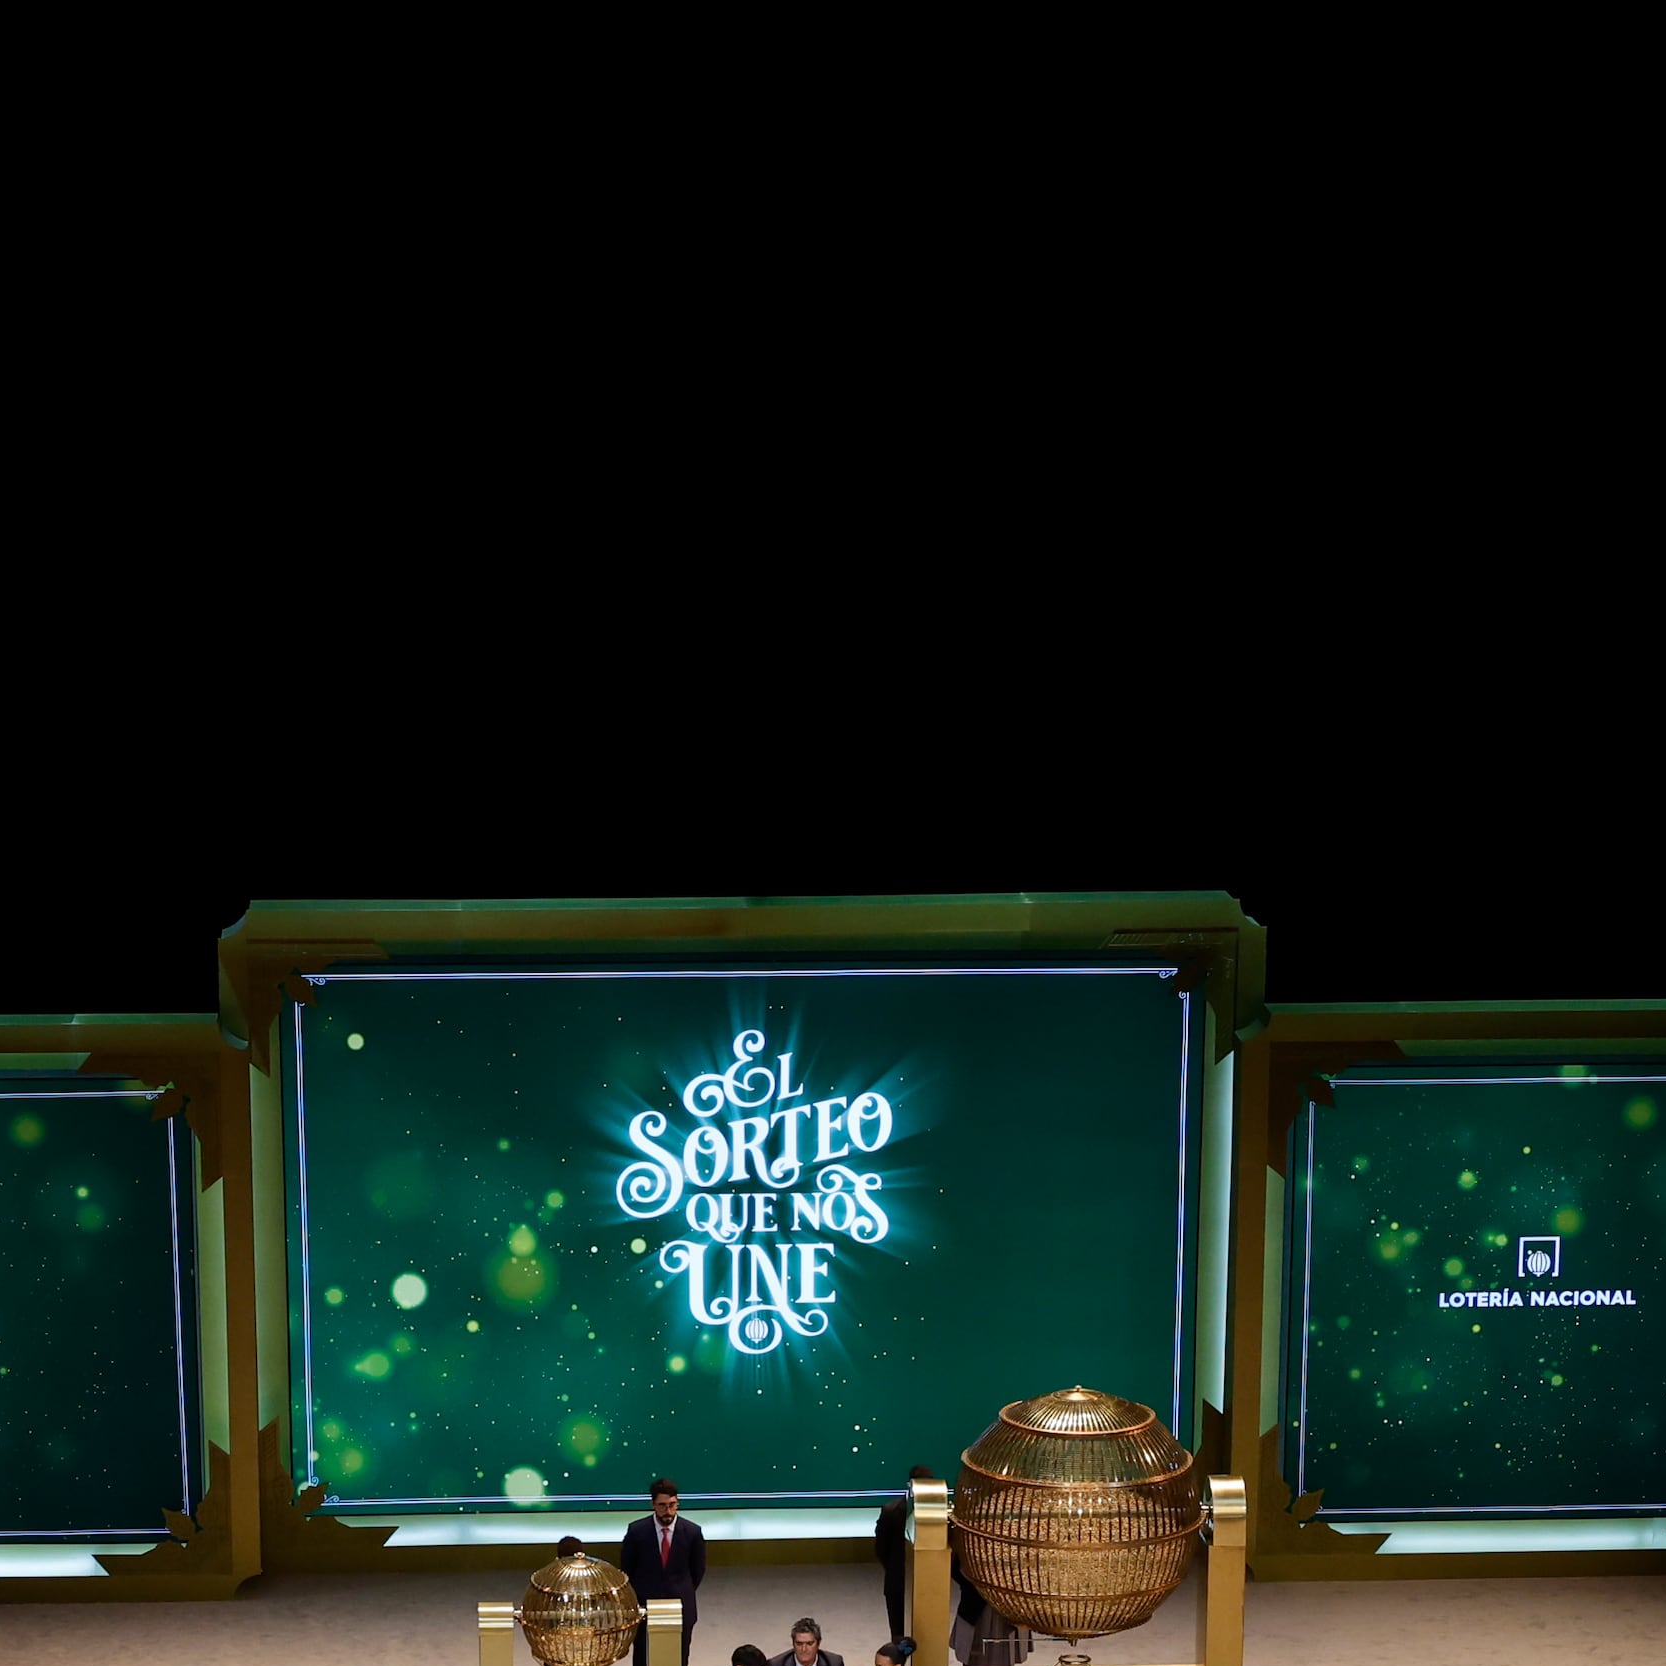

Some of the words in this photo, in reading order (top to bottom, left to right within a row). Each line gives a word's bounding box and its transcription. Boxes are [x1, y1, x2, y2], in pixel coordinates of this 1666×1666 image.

[683, 1029, 804, 1118] EL
[616, 1091, 893, 1218] SORTEO
[685, 1193, 778, 1243] QUE
[790, 1164, 889, 1244] NOS
[659, 1240, 837, 1354] UNE
[1439, 1288, 1524, 1308] LOTERÍA
[1530, 1290, 1637, 1307] NACIONAL
